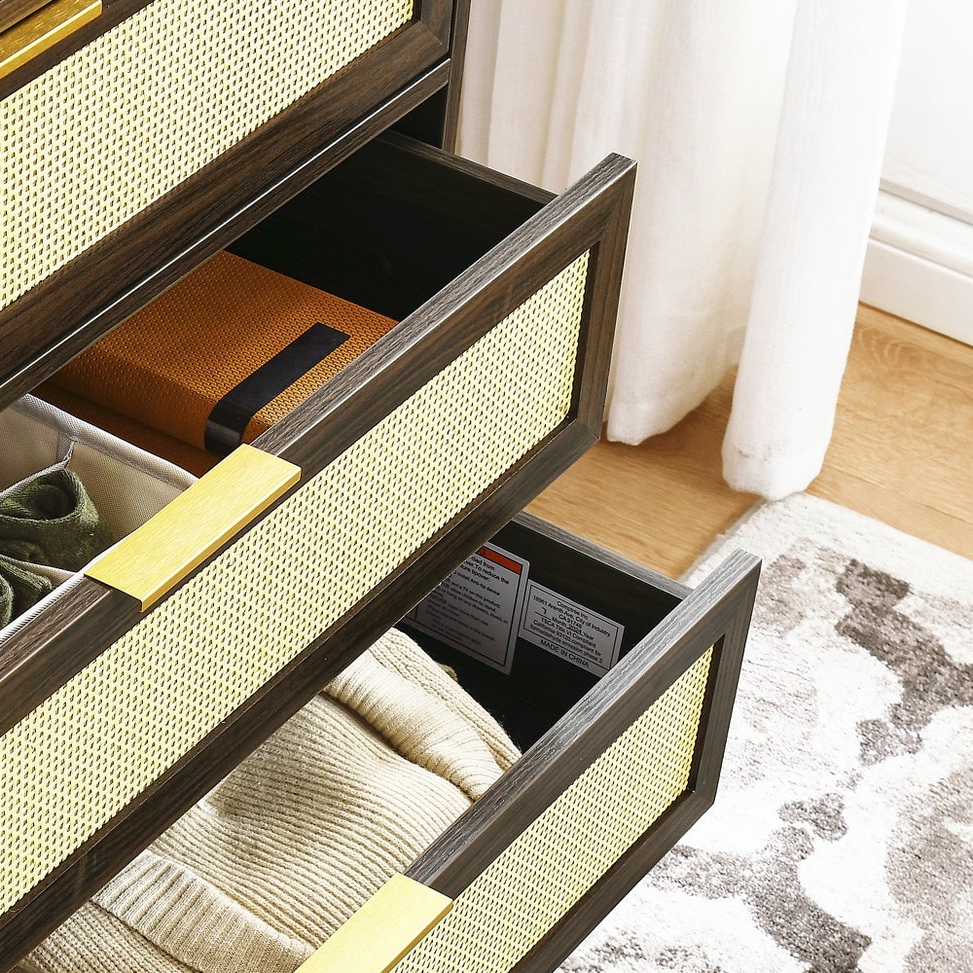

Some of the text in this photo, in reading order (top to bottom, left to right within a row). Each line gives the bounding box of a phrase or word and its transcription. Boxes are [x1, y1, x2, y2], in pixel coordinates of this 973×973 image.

[483, 561, 495, 571] from
[483, 568, 500, 581] reduce
[501, 577, 509, 585] the
[533, 619, 555, 634] California
[571, 638, 593, 653] compliant
[541, 617, 555, 628] TSCA
[572, 632, 596, 649] Compliant
[575, 616, 585, 625] City
[591, 624, 611, 638] Industry
[541, 639, 589, 668] MADE IN CHINA
